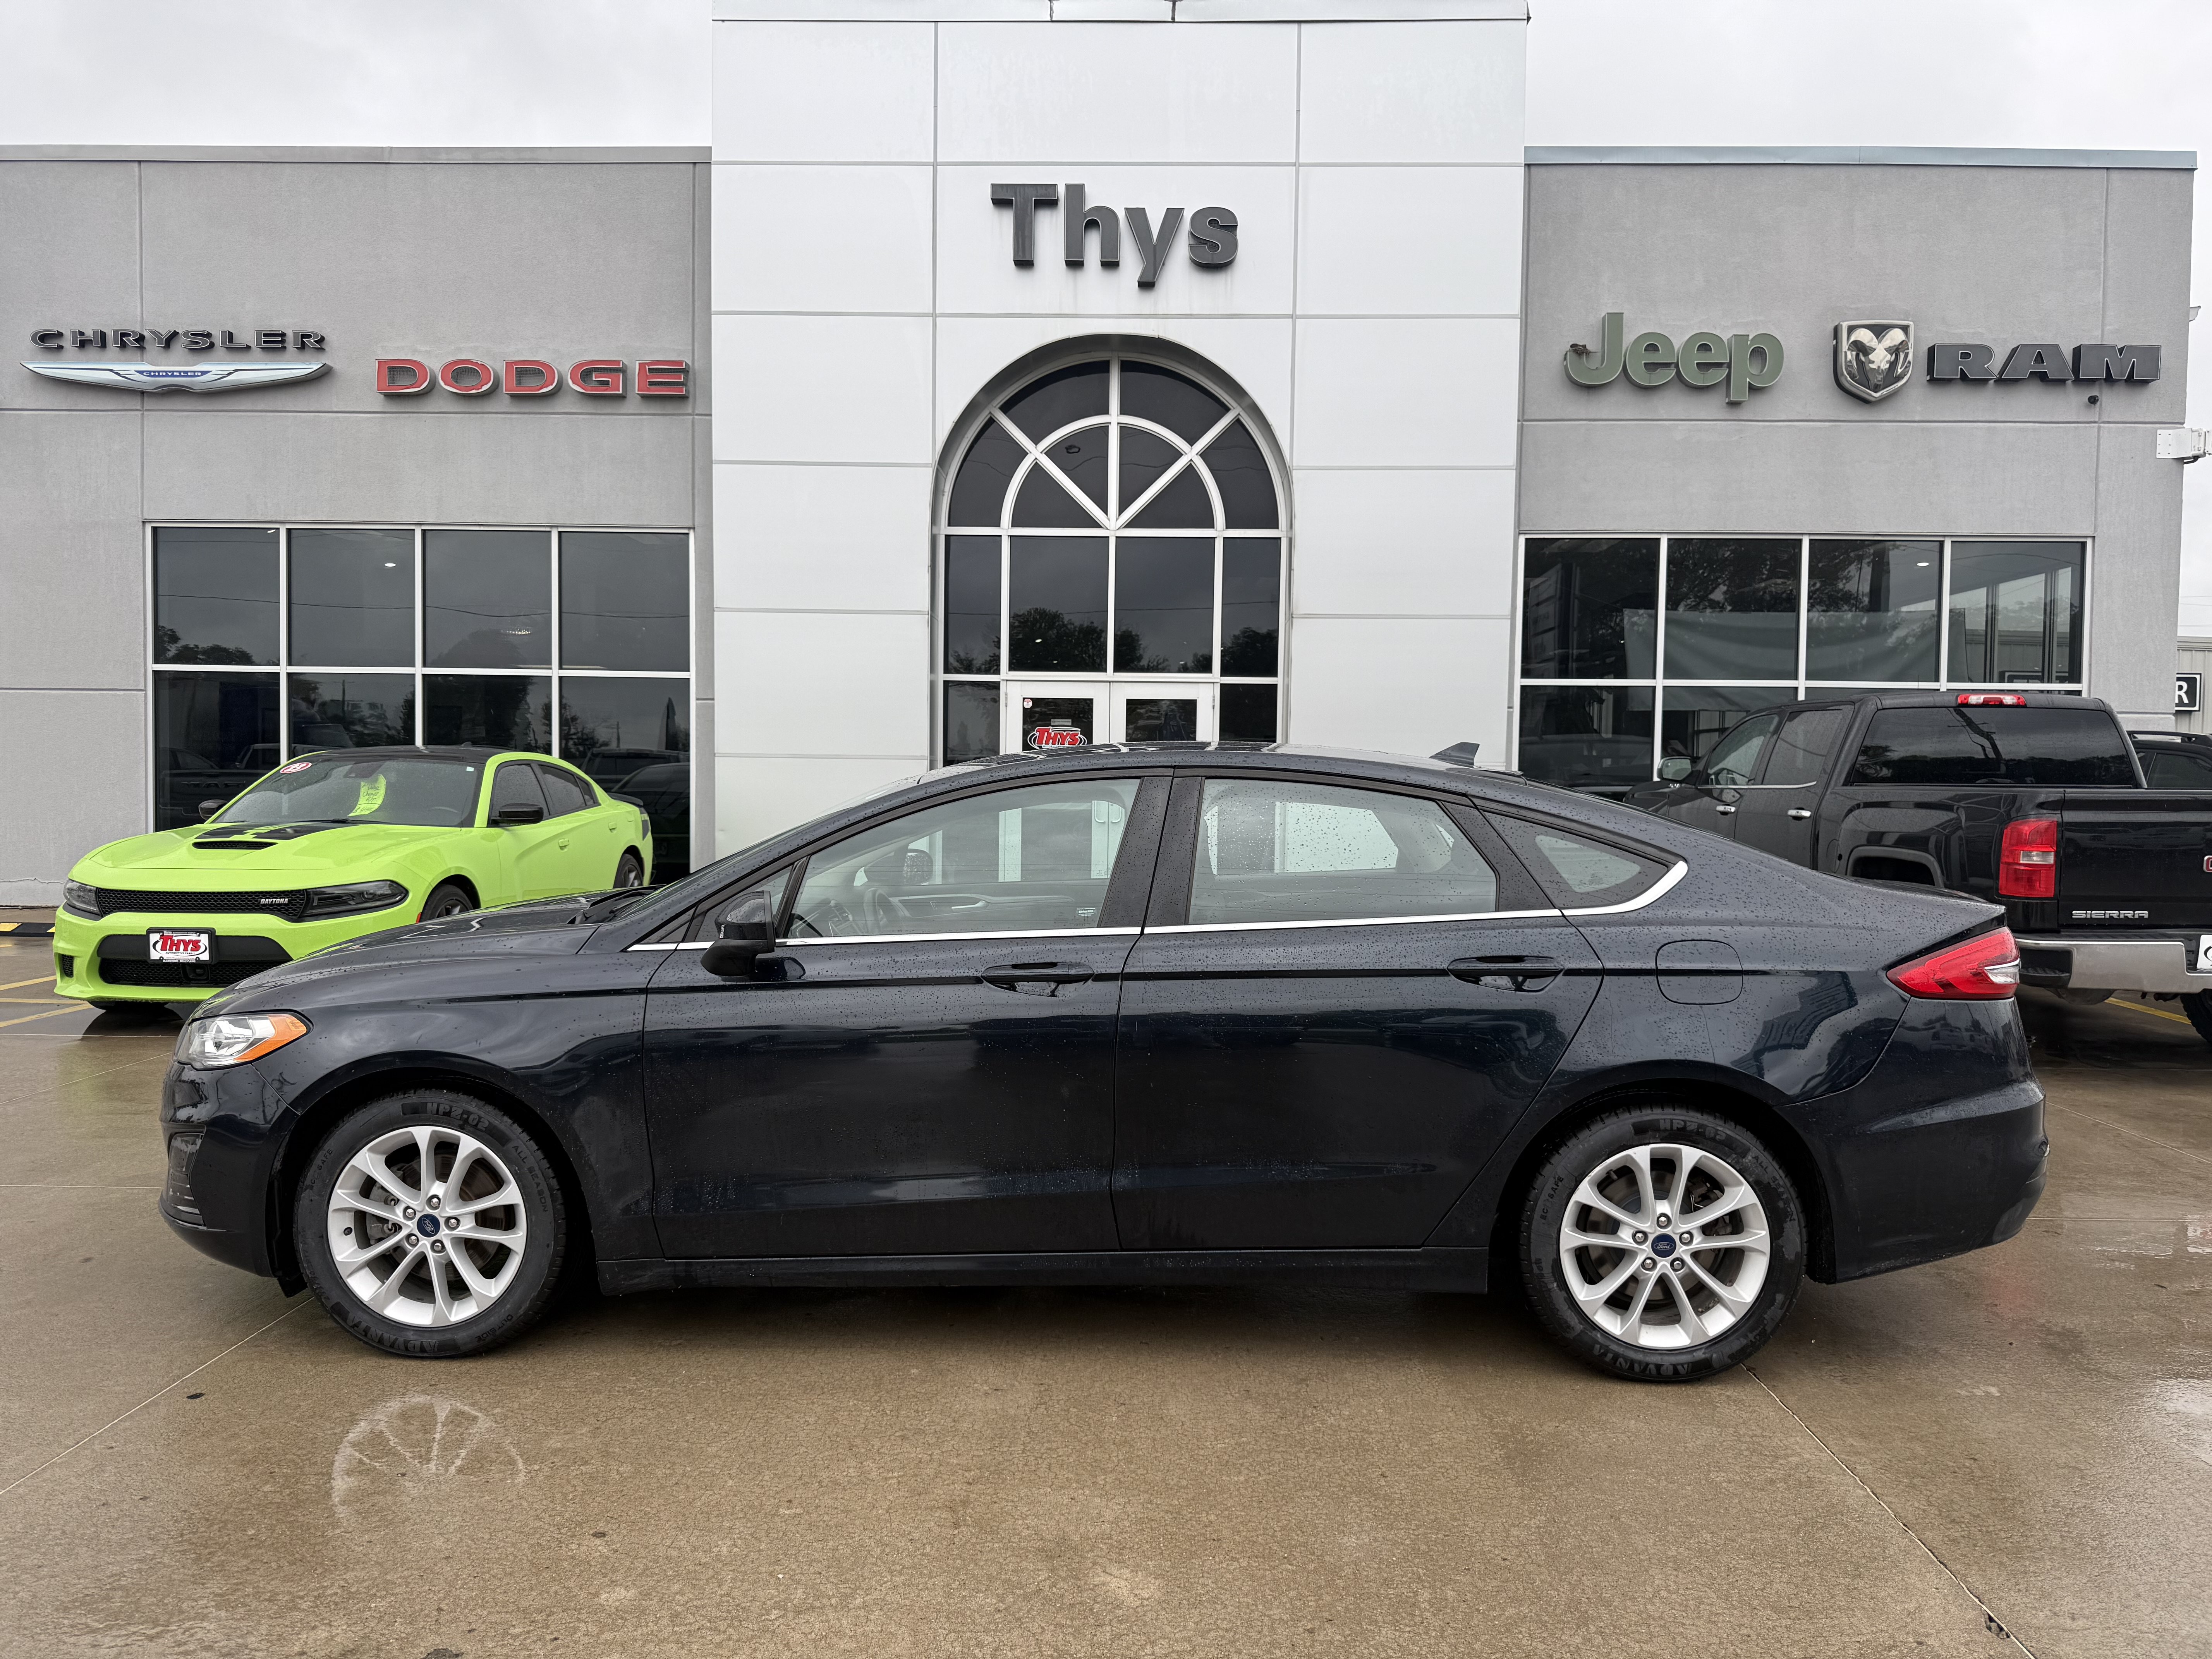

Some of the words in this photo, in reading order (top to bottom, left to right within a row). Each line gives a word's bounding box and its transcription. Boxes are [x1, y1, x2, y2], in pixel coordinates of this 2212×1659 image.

[991, 184, 1238, 287] Thys
[29, 328, 325, 351] CHRYSLER
[1564, 312, 1784, 404] Jeep
[375, 359, 689, 397] DODGE
[1927, 343, 2162, 385] RAM
[1036, 727, 1080, 745] THYS
[160, 935, 201, 951] THYS
[427, 1102, 489, 1131] HPZ-02
[512, 1145, 527, 1164] ALL
[527, 1166, 549, 1212] SEASON
[346, 1312, 439, 1353] ADVANTA
